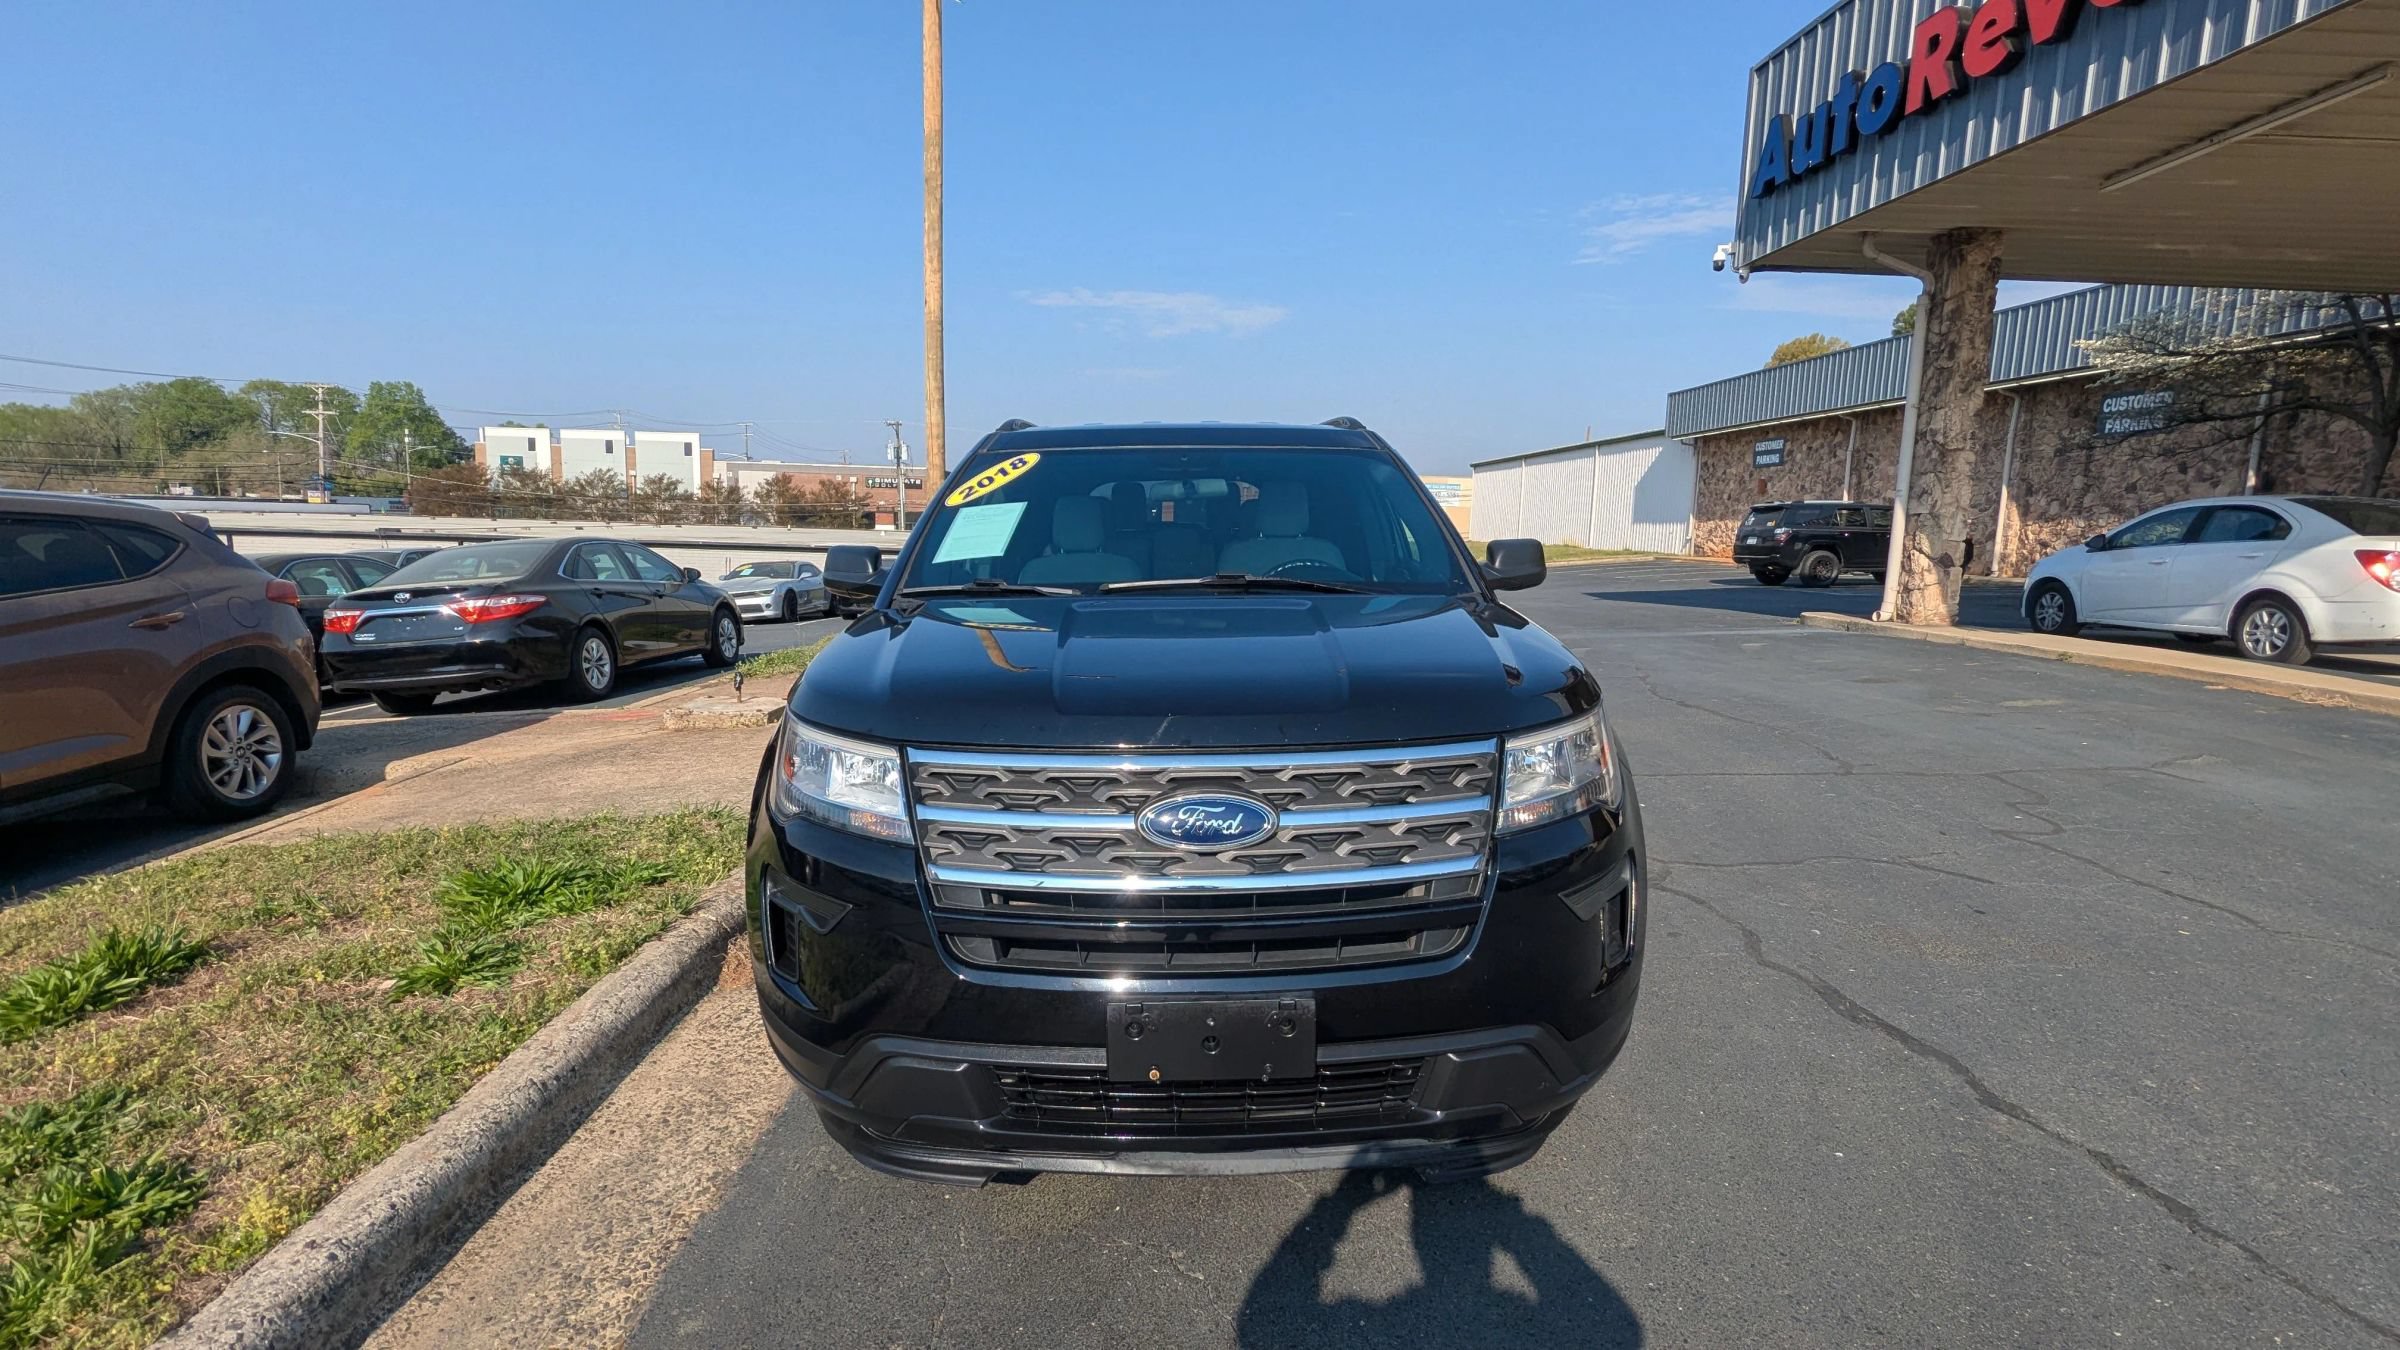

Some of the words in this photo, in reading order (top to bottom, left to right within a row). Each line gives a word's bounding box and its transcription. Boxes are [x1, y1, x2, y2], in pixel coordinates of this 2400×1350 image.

[1751, 0, 2128, 199] AutoRev
[1755, 439, 1785, 451] CUSTOMER
[1755, 453, 1780, 465] PARKING
[874, 477, 921, 485] SIMUATE
[958, 457, 1029, 501] 2018
[1171, 805, 1244, 836] Ford
